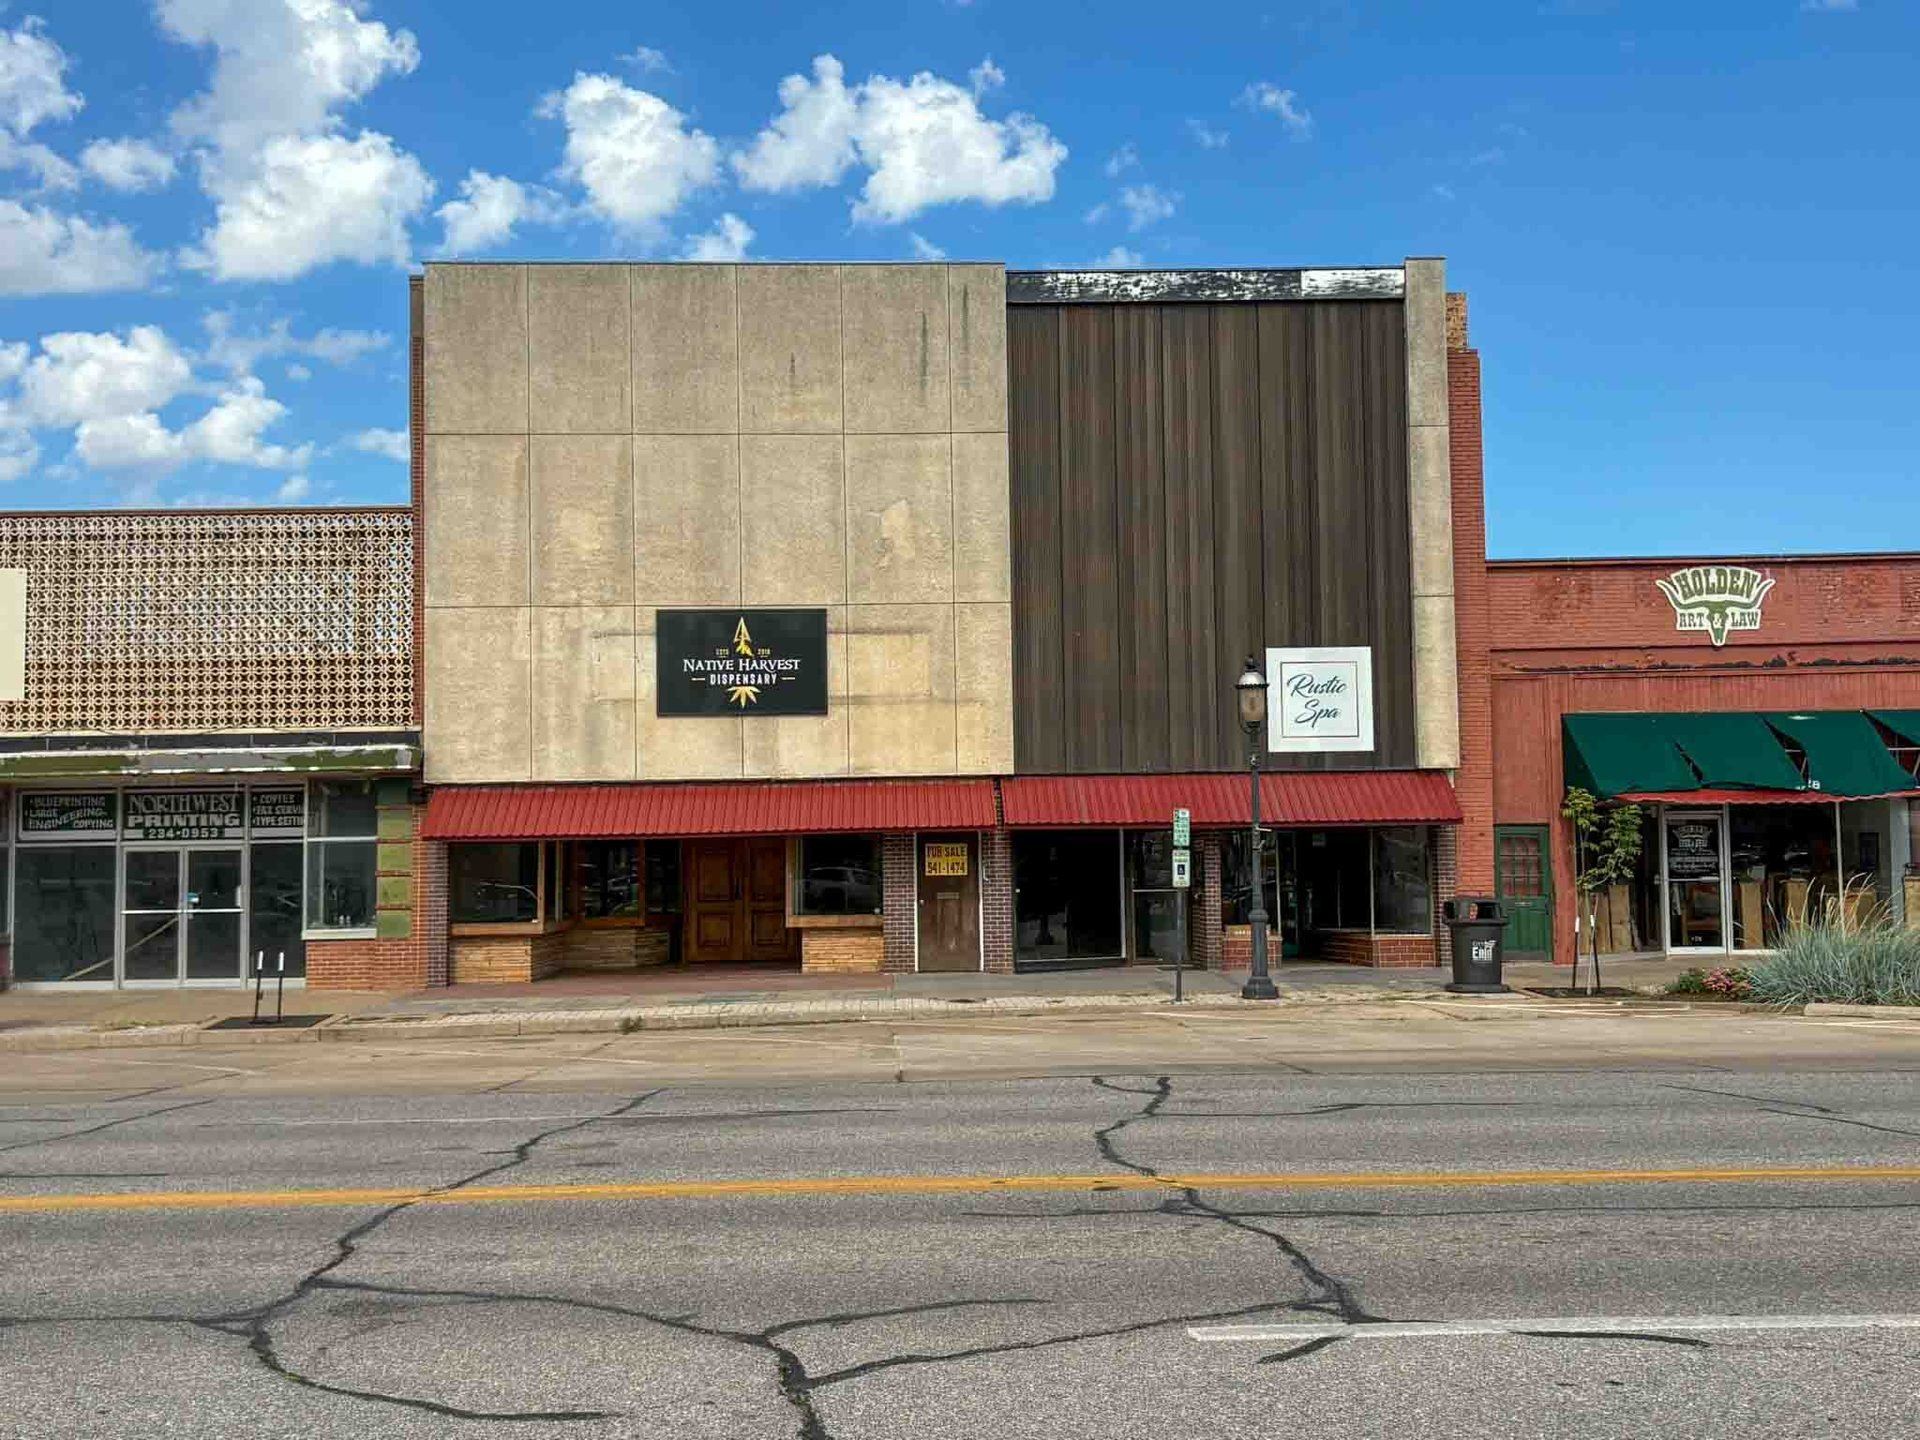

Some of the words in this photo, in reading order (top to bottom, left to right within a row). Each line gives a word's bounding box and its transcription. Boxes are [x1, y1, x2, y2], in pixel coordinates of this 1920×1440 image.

[1674, 567, 1759, 600] HOLDEN
[1679, 612, 1705, 628] ART
[1731, 611, 1760, 627] LAW
[682, 658, 734, 672] NATIVE
[738, 658, 803, 674] HARVEST
[710, 673, 778, 685] DISPENSARY
[1286, 672, 1348, 698] Rustic
[1294, 698, 1341, 728] Spa
[127, 793, 241, 813] NORTHWEST
[73, 819, 114, 829] COPYING
[127, 813, 241, 828] PRINTING
[148, 828, 219, 839] 234-0953
[927, 846, 942, 857] FOR
[944, 846, 966, 857] SALE
[927, 861, 966, 874] 541-1474
